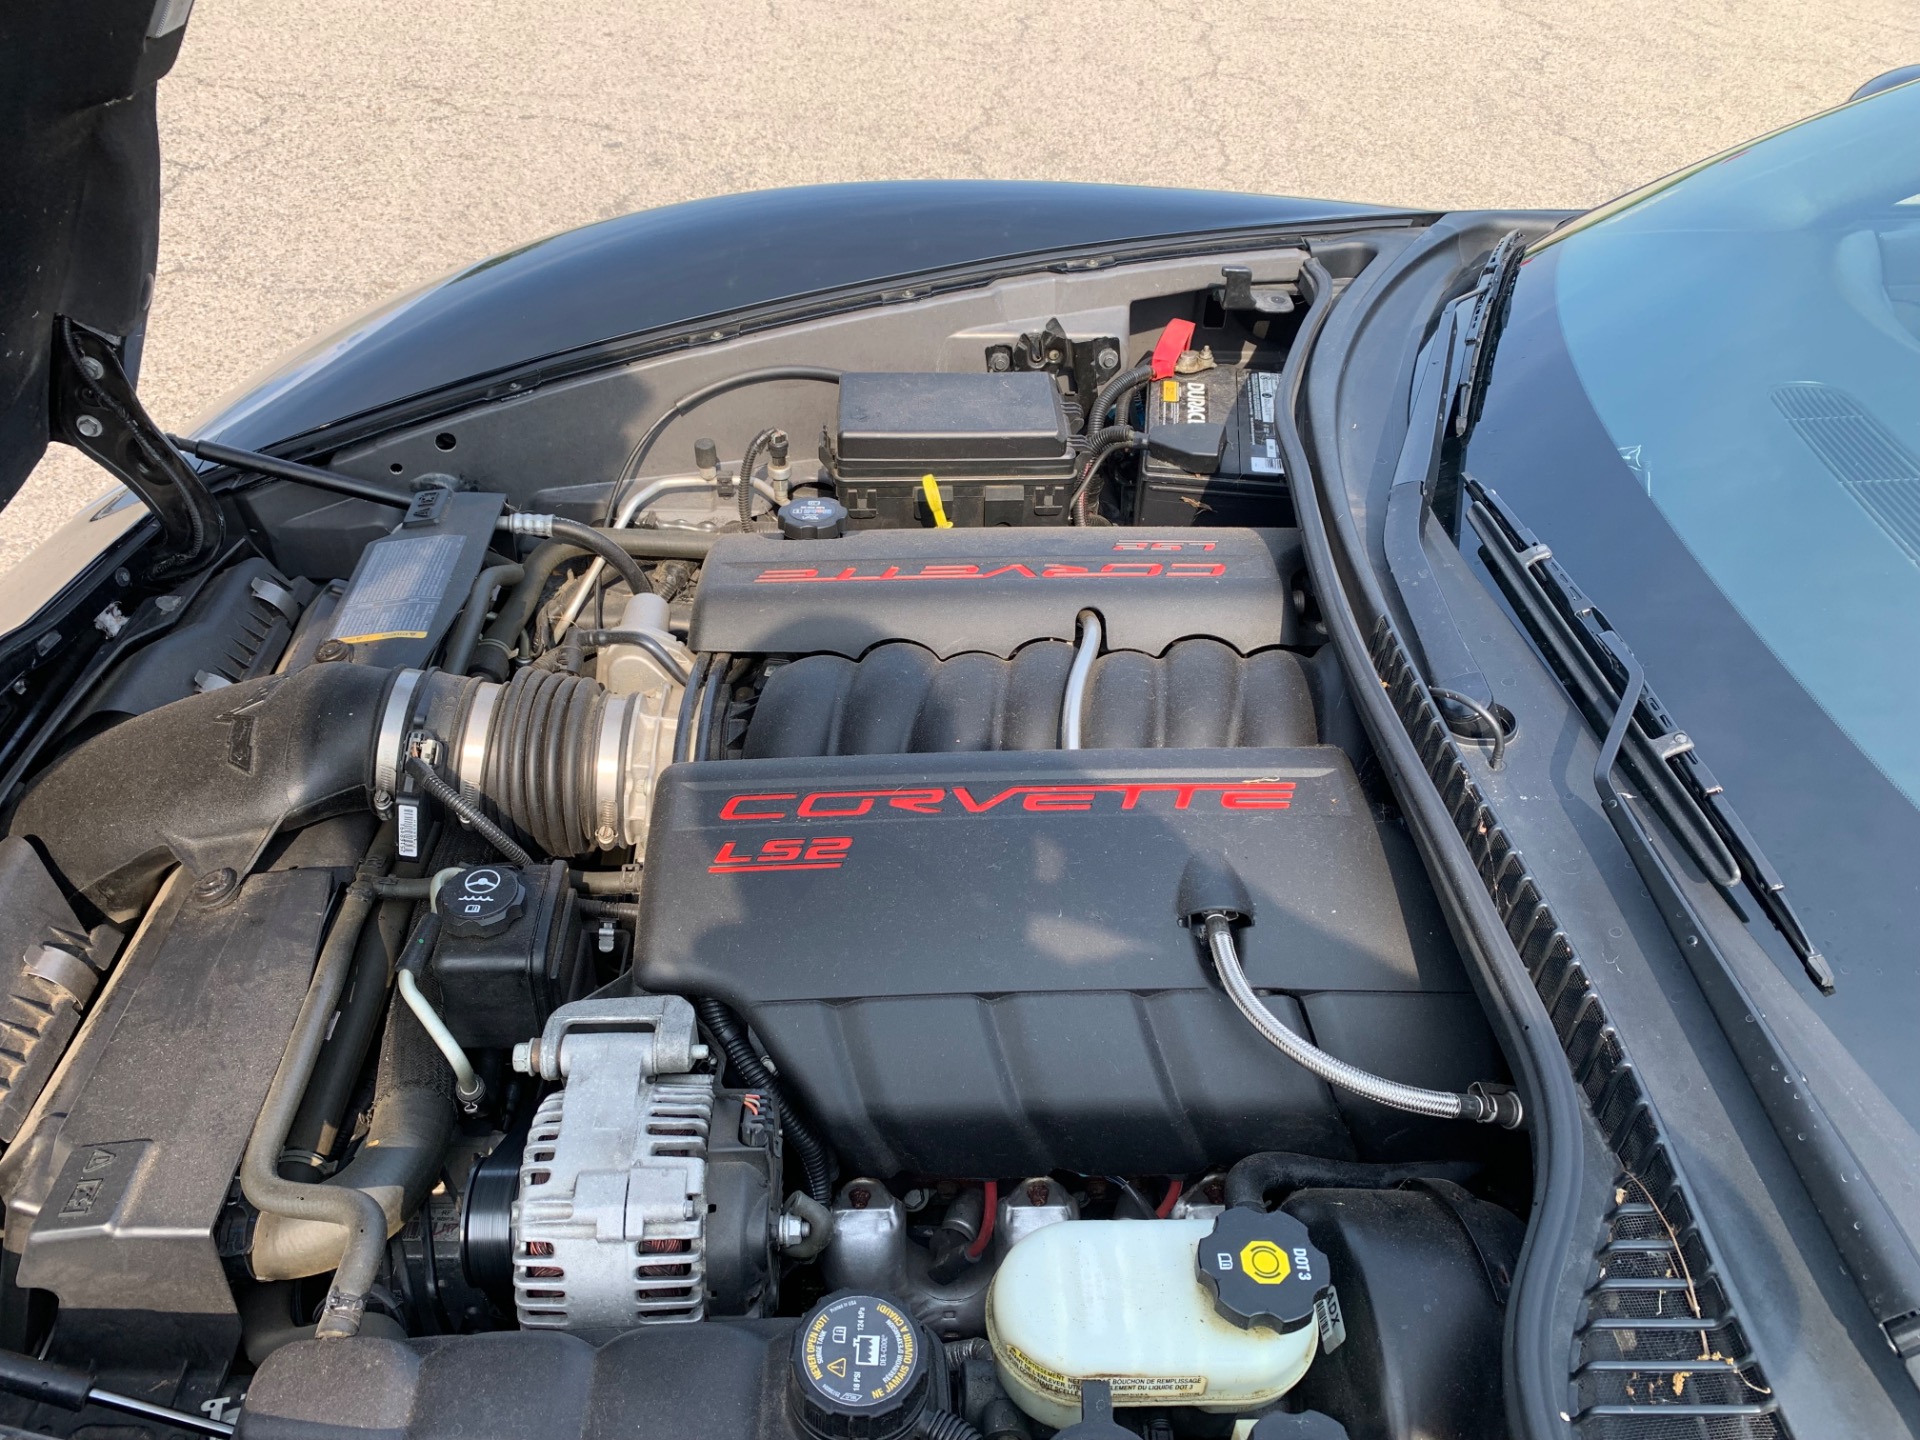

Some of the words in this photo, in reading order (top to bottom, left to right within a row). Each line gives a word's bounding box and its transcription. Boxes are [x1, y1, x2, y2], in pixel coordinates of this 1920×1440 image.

[753, 563, 1226, 583] CORVETTE
[719, 781, 1297, 821] CORVETTE
[713, 837, 853, 866] LS2
[1293, 1248, 1311, 1272] DOT
[1298, 1273, 1312, 1281] 3
[858, 1307, 866, 1317] kPa
[876, 1303, 905, 1326] CHAUD!
[1325, 1291, 1341, 1328] ADX
[812, 1314, 830, 1332] HOT!
[857, 1318, 865, 1331] 124
[806, 1331, 818, 1353] OPEN
[817, 1330, 828, 1345] TANK
[815, 1345, 824, 1364] SURGE
[904, 1334, 913, 1364] OUVRIR
[807, 1354, 823, 1380] NEVER
[853, 1371, 861, 1383] PSI
[1018, 1352, 1065, 1382] AVERTISSEMENT
[853, 1383, 860, 1391] 18
[885, 1365, 910, 1393] JAMAIS
[871, 1387, 885, 1399] NE
